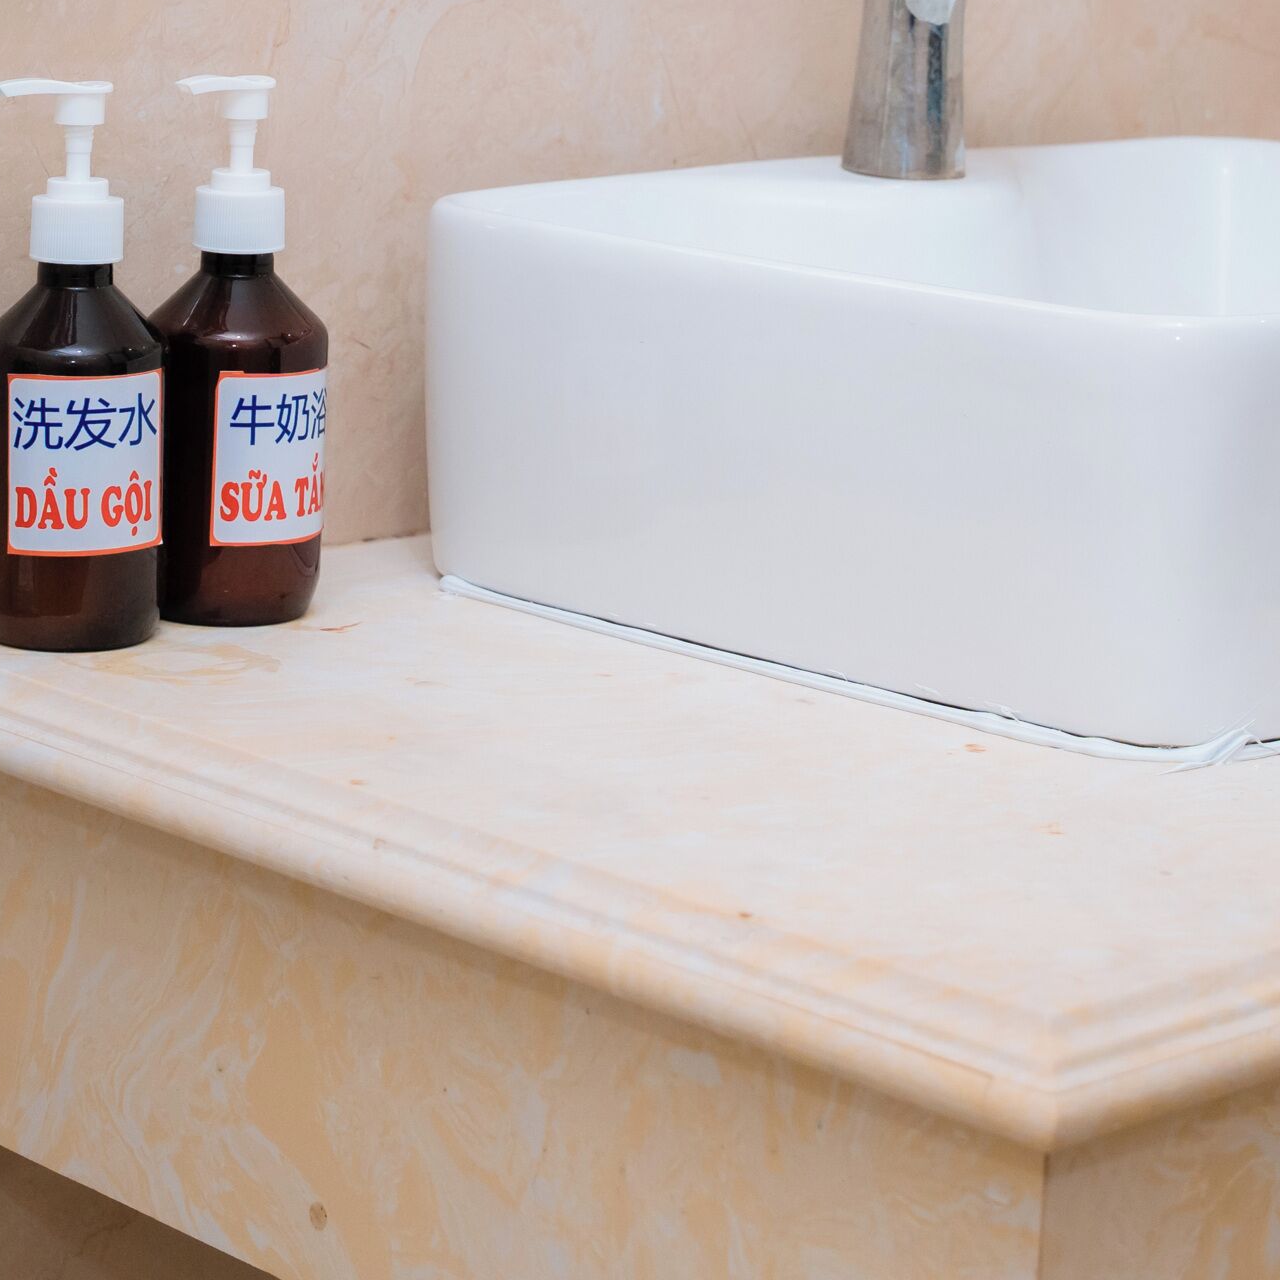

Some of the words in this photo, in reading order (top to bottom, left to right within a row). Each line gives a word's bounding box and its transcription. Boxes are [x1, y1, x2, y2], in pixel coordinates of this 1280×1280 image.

[12, 392, 157, 451] 洗发水
[15, 467, 91, 529] DẦU
[101, 470, 152, 536] GỘI
[220, 469, 287, 522] SỮA
